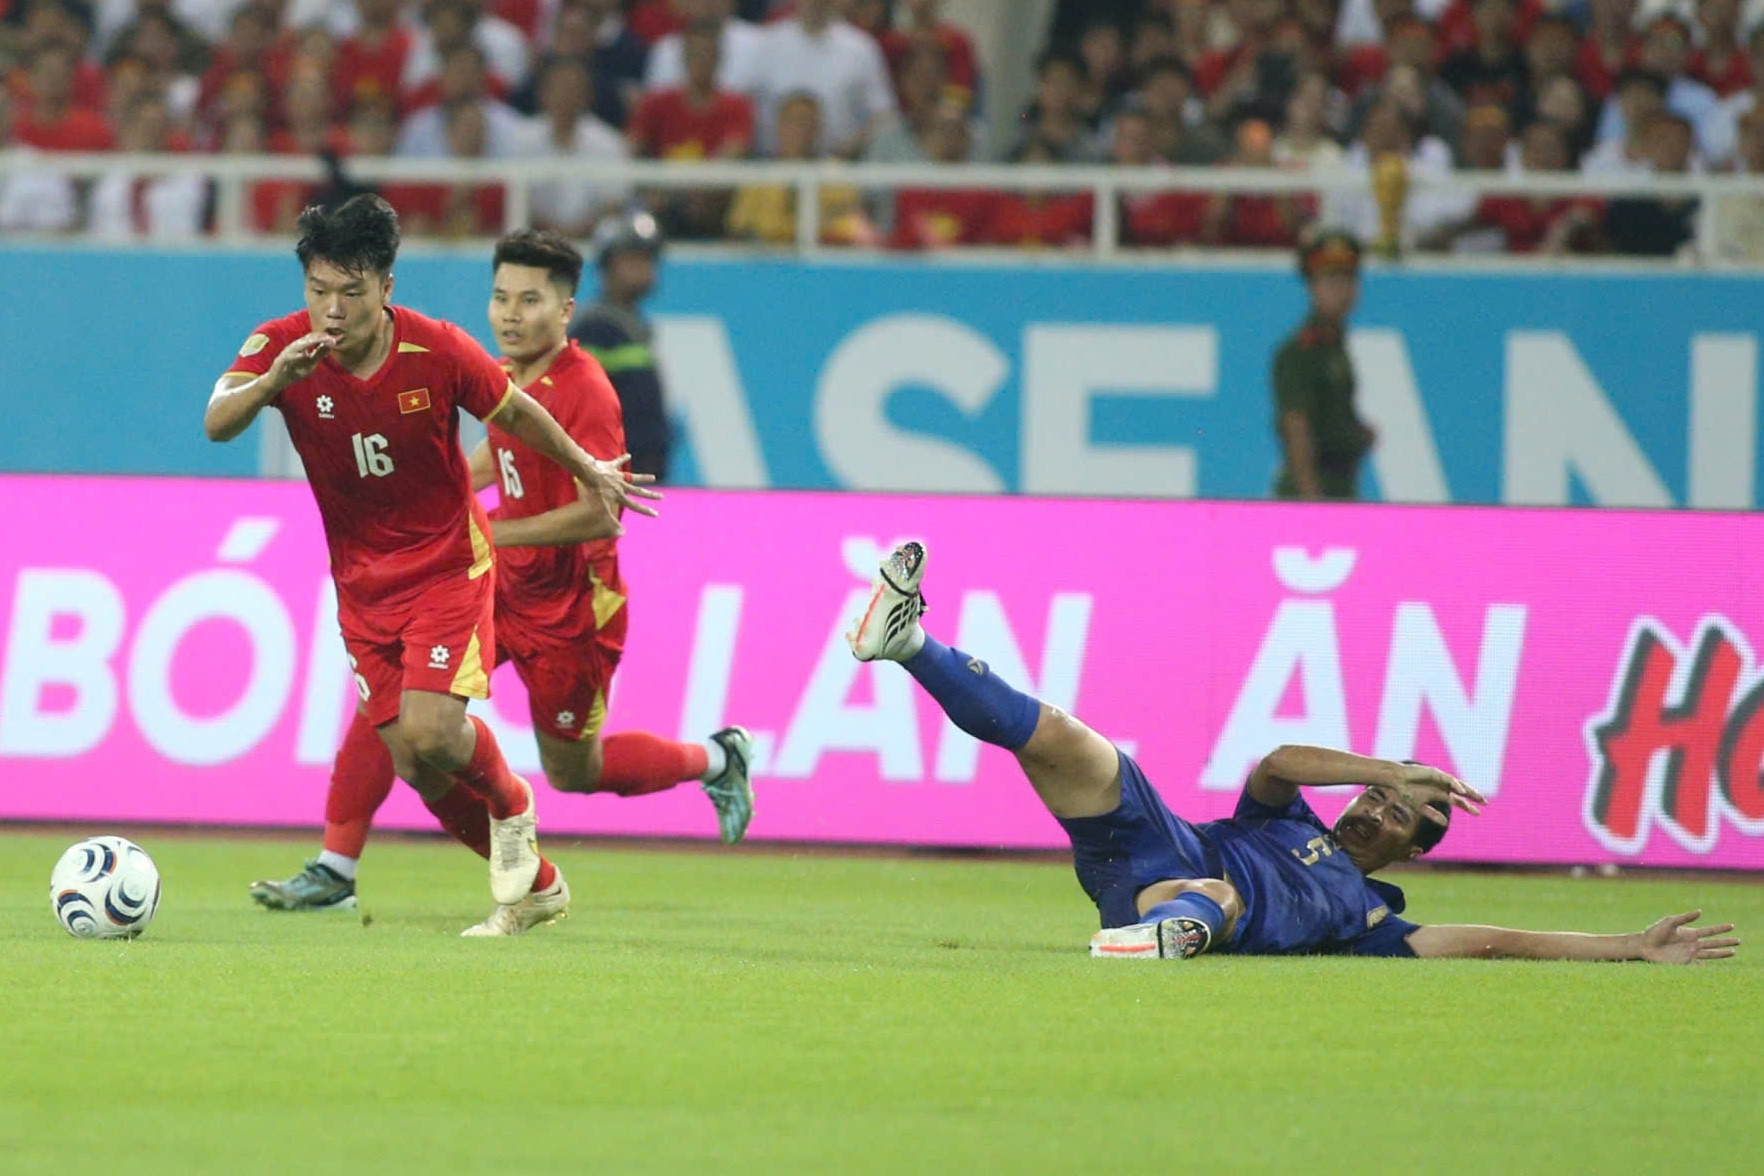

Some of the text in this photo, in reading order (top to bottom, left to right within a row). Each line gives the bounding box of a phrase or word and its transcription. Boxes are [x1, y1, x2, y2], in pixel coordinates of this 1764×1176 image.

[352, 432, 395, 478] 16
[497, 447, 525, 498] 15
[676, 535, 1137, 784] LĂN
[1199, 546, 1529, 796] ĂN
